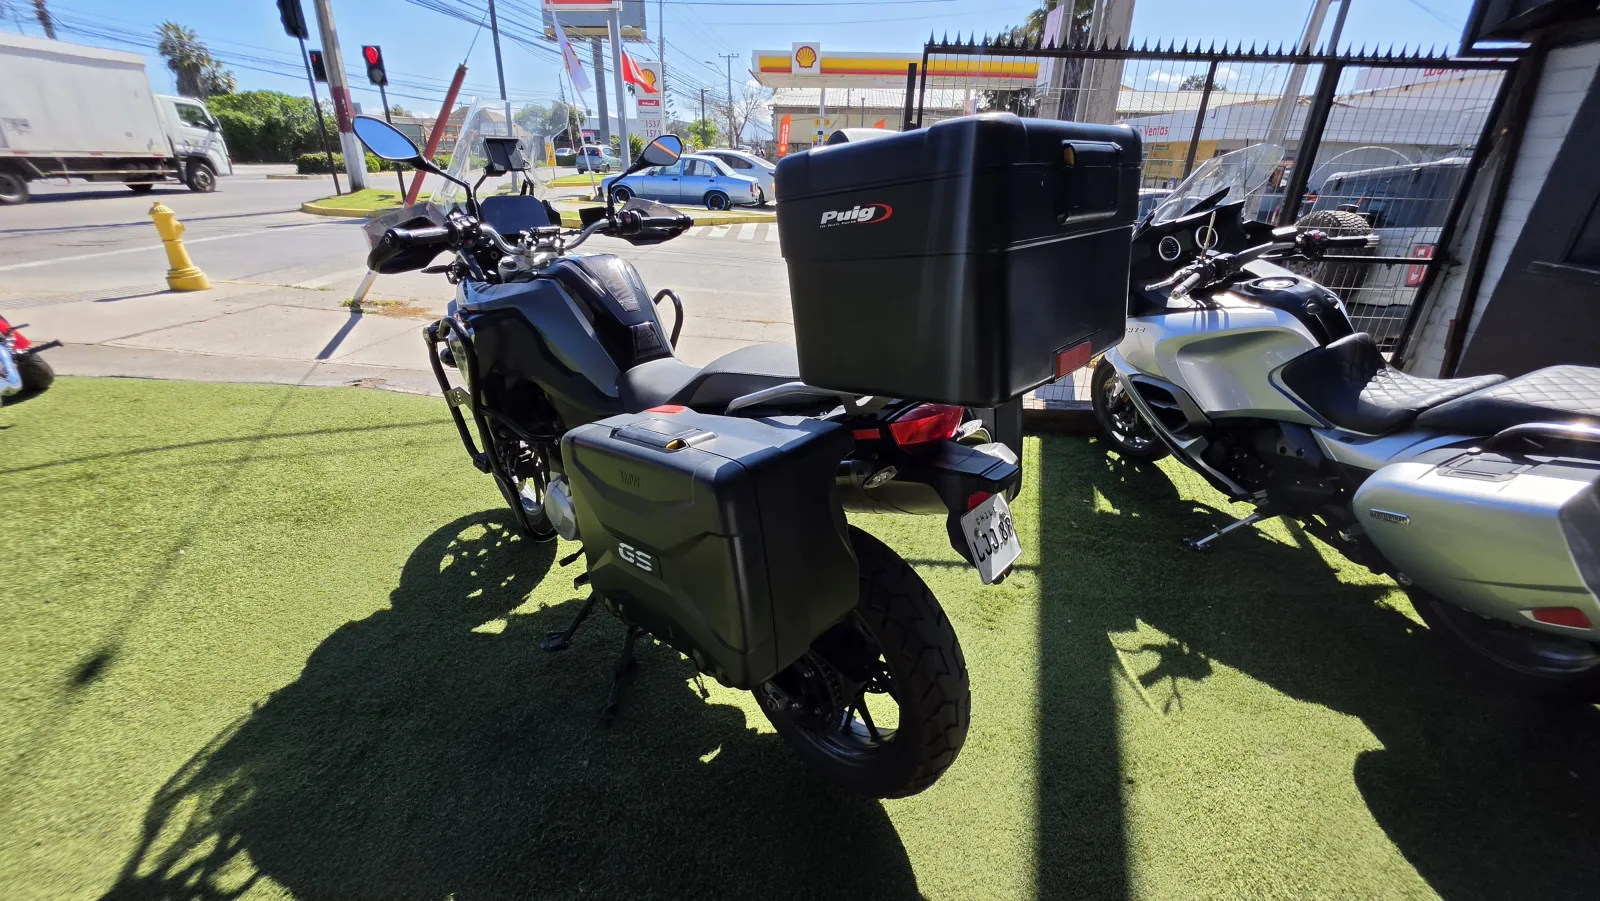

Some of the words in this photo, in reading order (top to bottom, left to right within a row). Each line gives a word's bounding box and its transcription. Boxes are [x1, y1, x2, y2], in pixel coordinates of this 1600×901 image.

[1144, 126, 1169, 137] Ventas
[820, 205, 876, 224] Puig
[975, 506, 997, 526] CHILE
[618, 542, 652, 572] GS
